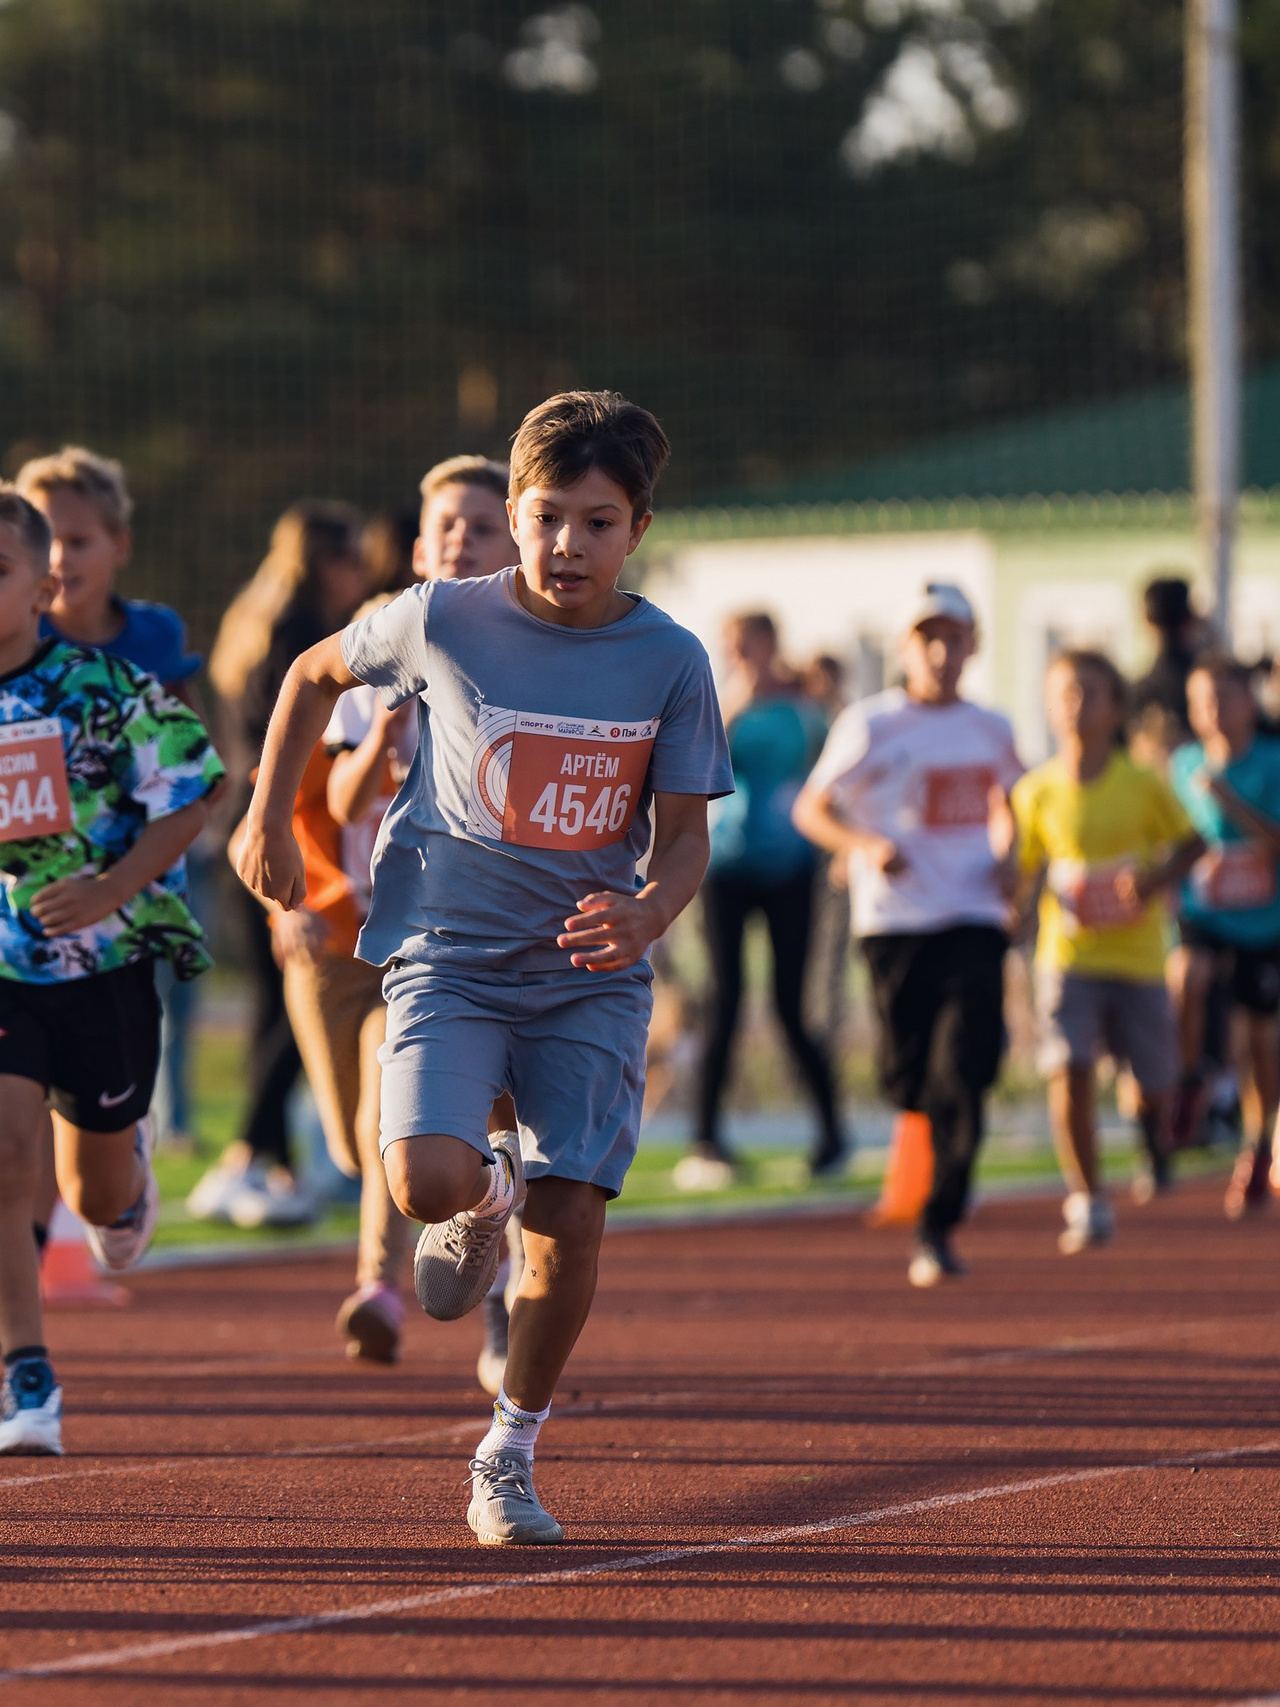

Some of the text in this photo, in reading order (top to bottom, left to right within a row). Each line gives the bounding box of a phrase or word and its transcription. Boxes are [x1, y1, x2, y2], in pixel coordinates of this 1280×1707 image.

[520, 720, 544, 728] СПОРТ
[621, 728, 637, 738] Пэй
[560, 753, 620, 778] АРТЁМ
[529, 782, 631, 836] 4546
